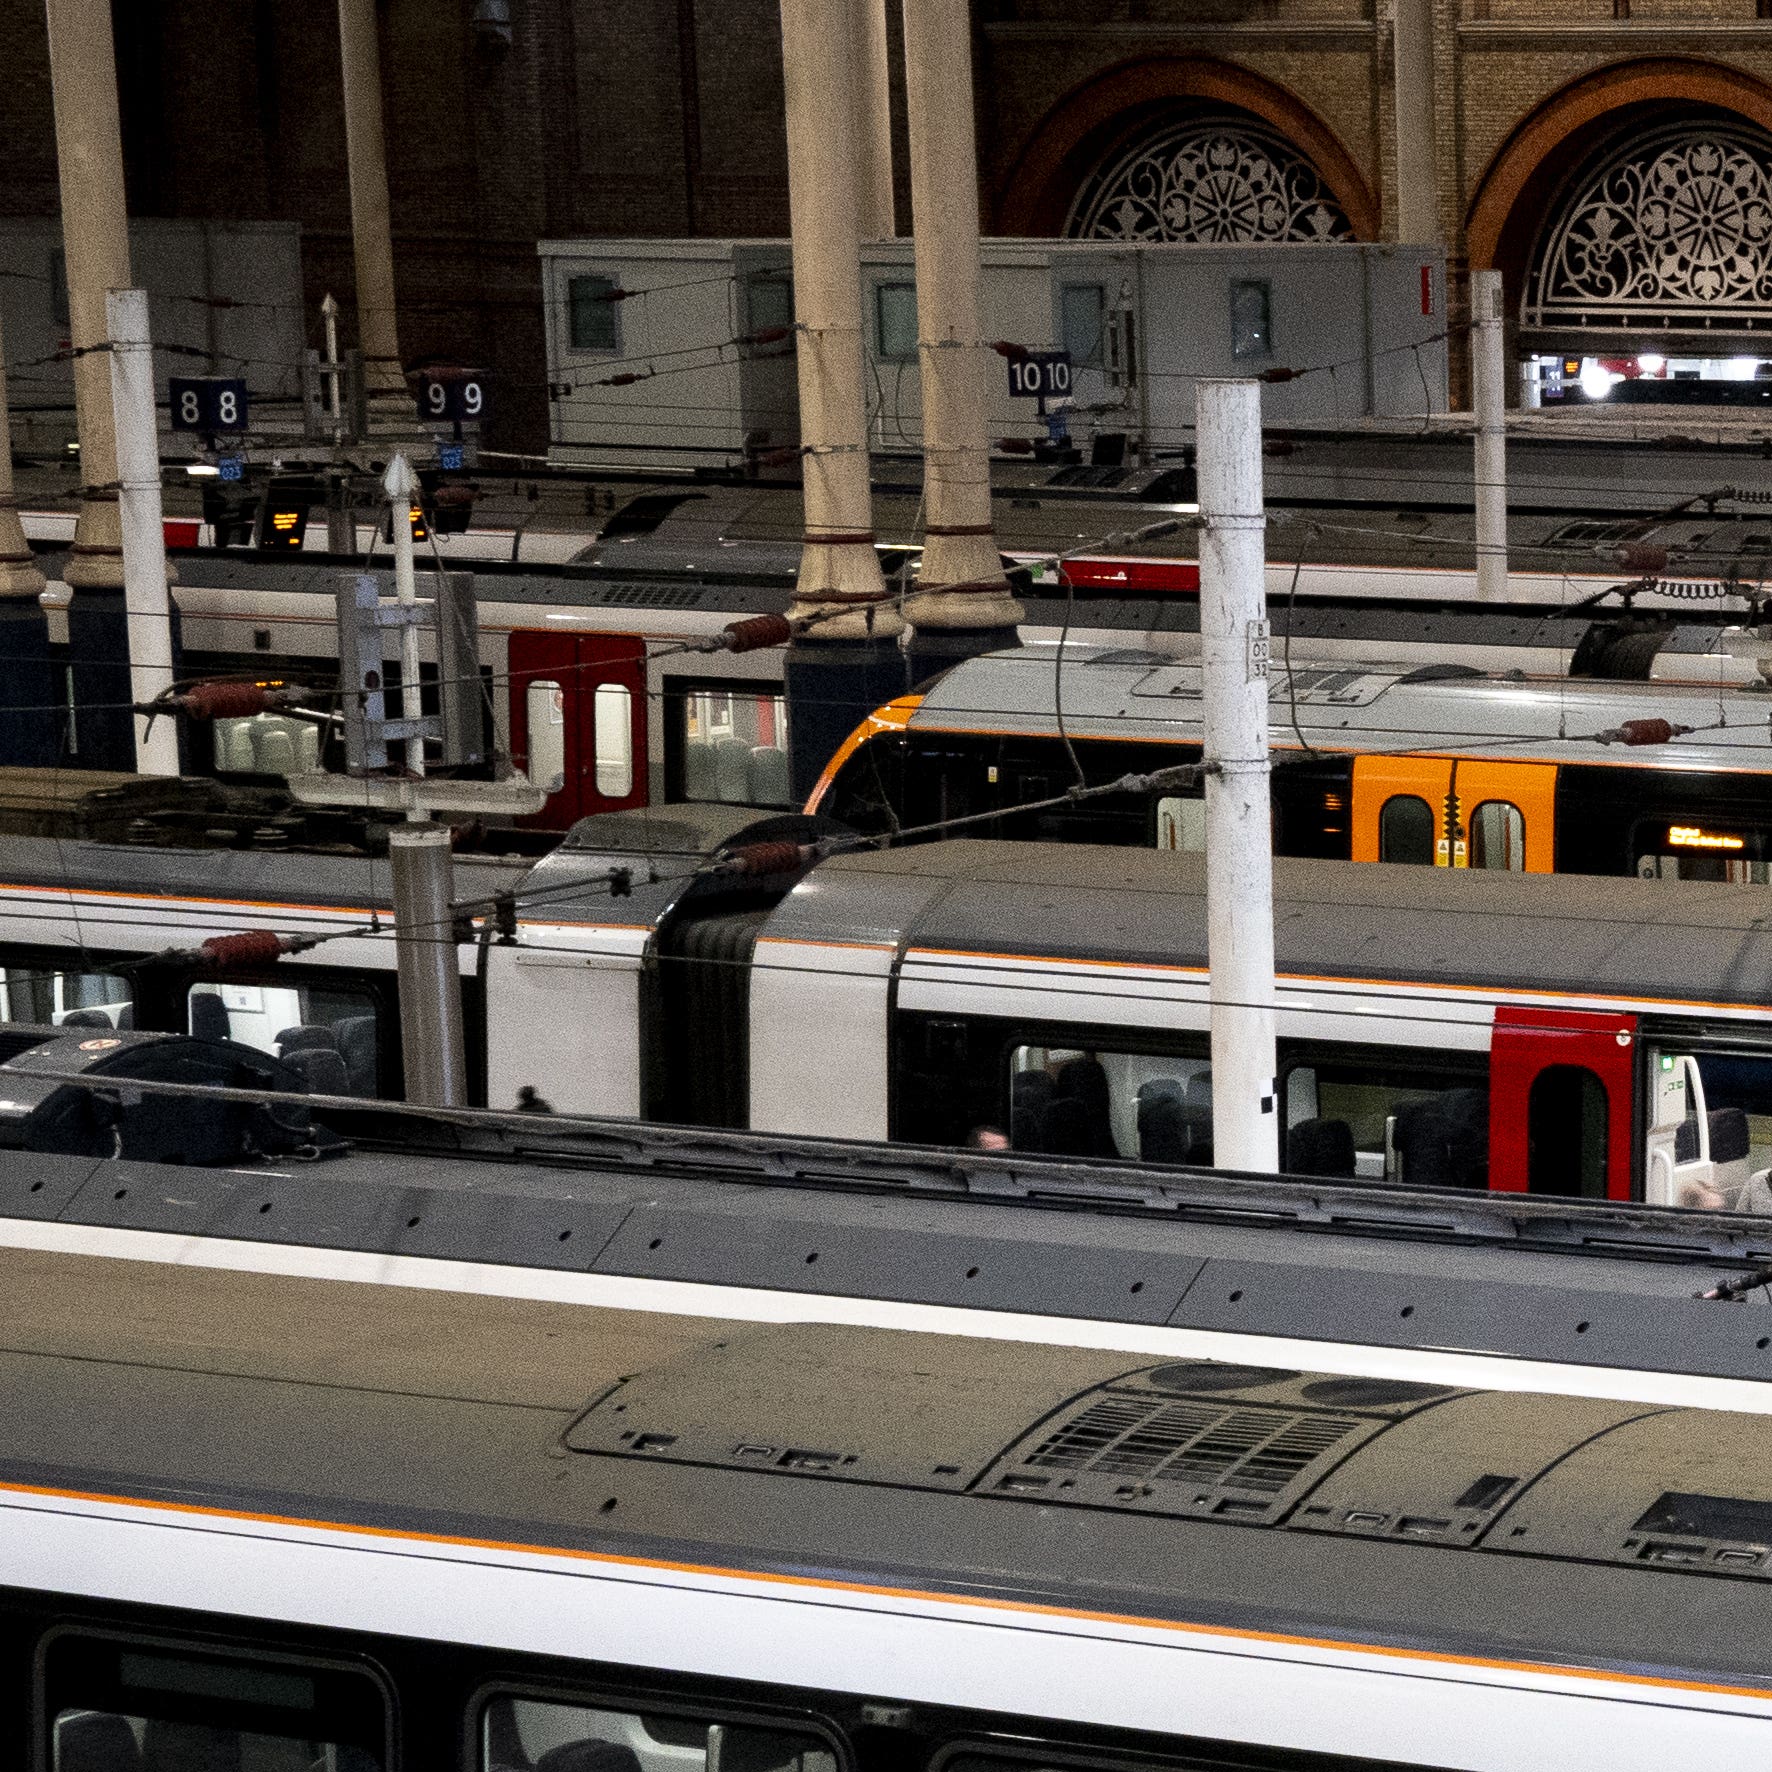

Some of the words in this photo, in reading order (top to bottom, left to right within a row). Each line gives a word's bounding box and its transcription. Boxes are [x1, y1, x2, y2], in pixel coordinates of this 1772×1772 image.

[1011, 362, 1042, 391] 10
[1045, 362, 1069, 390] 10
[181, 391, 199, 424] 8
[219, 391, 238, 424] 8
[428, 383, 446, 414] 9
[464, 382, 483, 414] 9
[1253, 663, 1268, 677] 32
